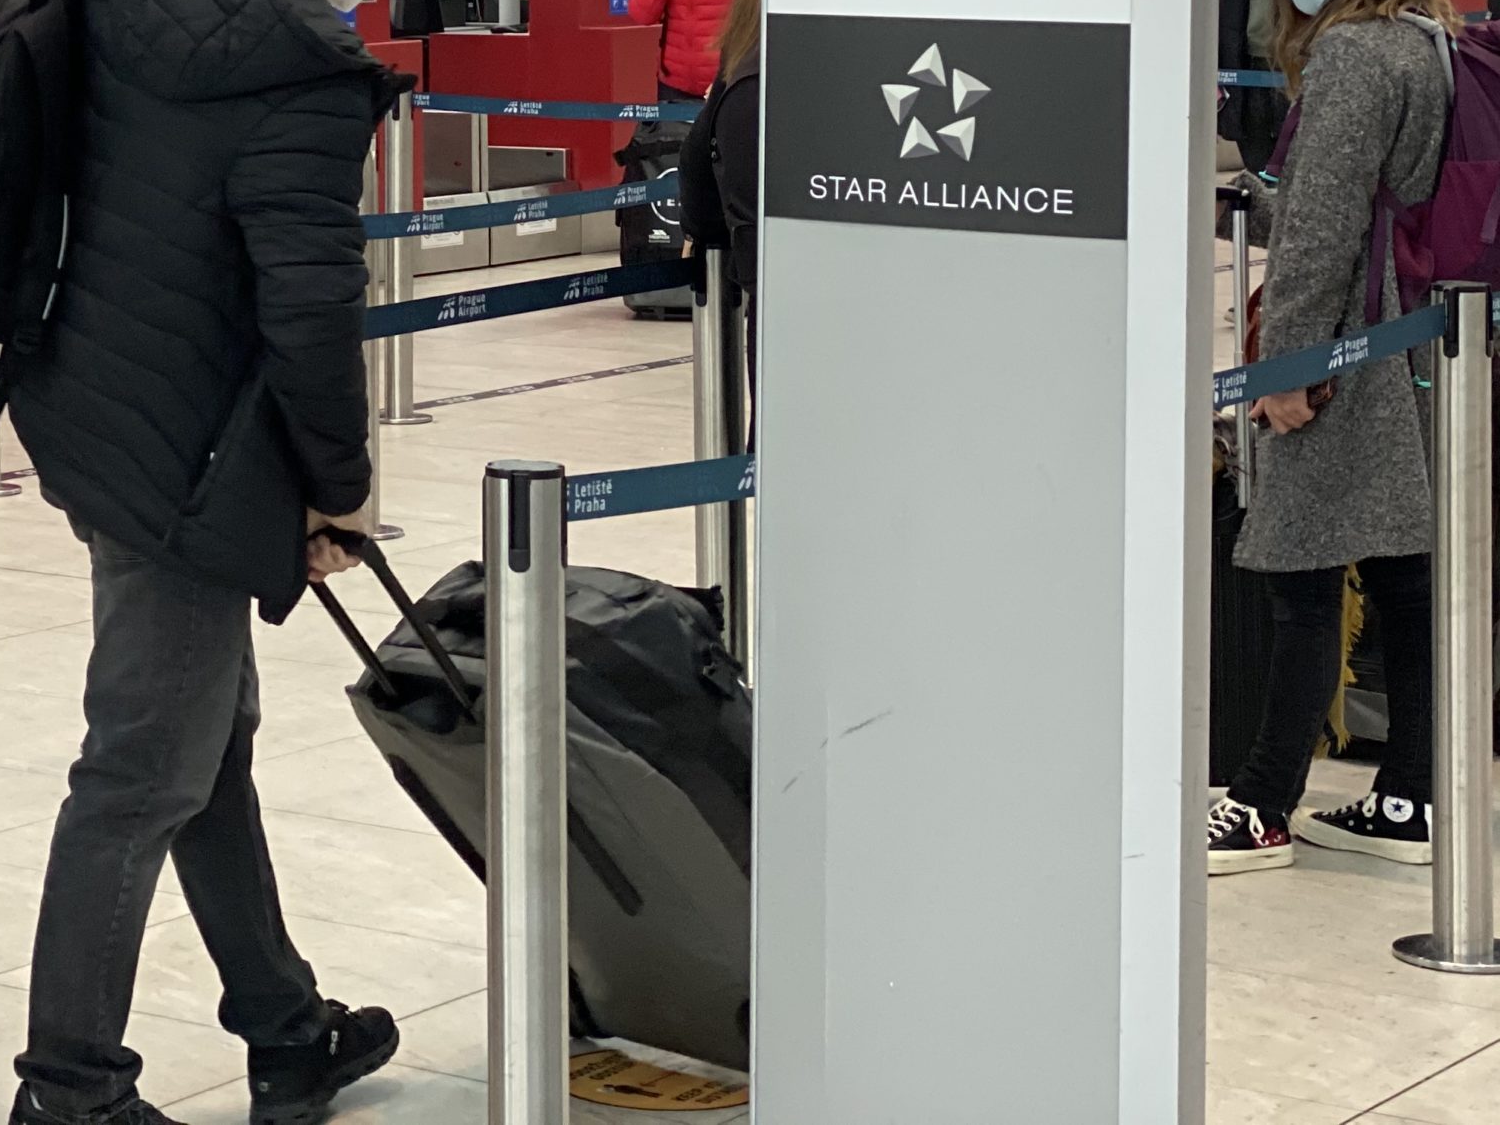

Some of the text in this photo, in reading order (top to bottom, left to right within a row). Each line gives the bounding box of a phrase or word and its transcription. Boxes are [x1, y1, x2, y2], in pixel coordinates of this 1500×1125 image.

[635, 104, 659, 113] Prague
[635, 111, 660, 119] Airport
[809, 175, 1074, 215] STAR ALLIANCE
[422, 213, 444, 223] Prague
[422, 221, 444, 232] Airport
[582, 272, 608, 286] Letiště
[582, 284, 604, 296] Praha
[458, 293, 486, 306] Prague
[458, 303, 486, 317] Airport
[1344, 336, 1368, 351] Prague
[1344, 348, 1369, 364] Airport
[1222, 371, 1247, 388] Letiště
[1222, 387, 1243, 401] Praha
[575, 479, 612, 498] Letiště
[574, 496, 606, 514] Praha
